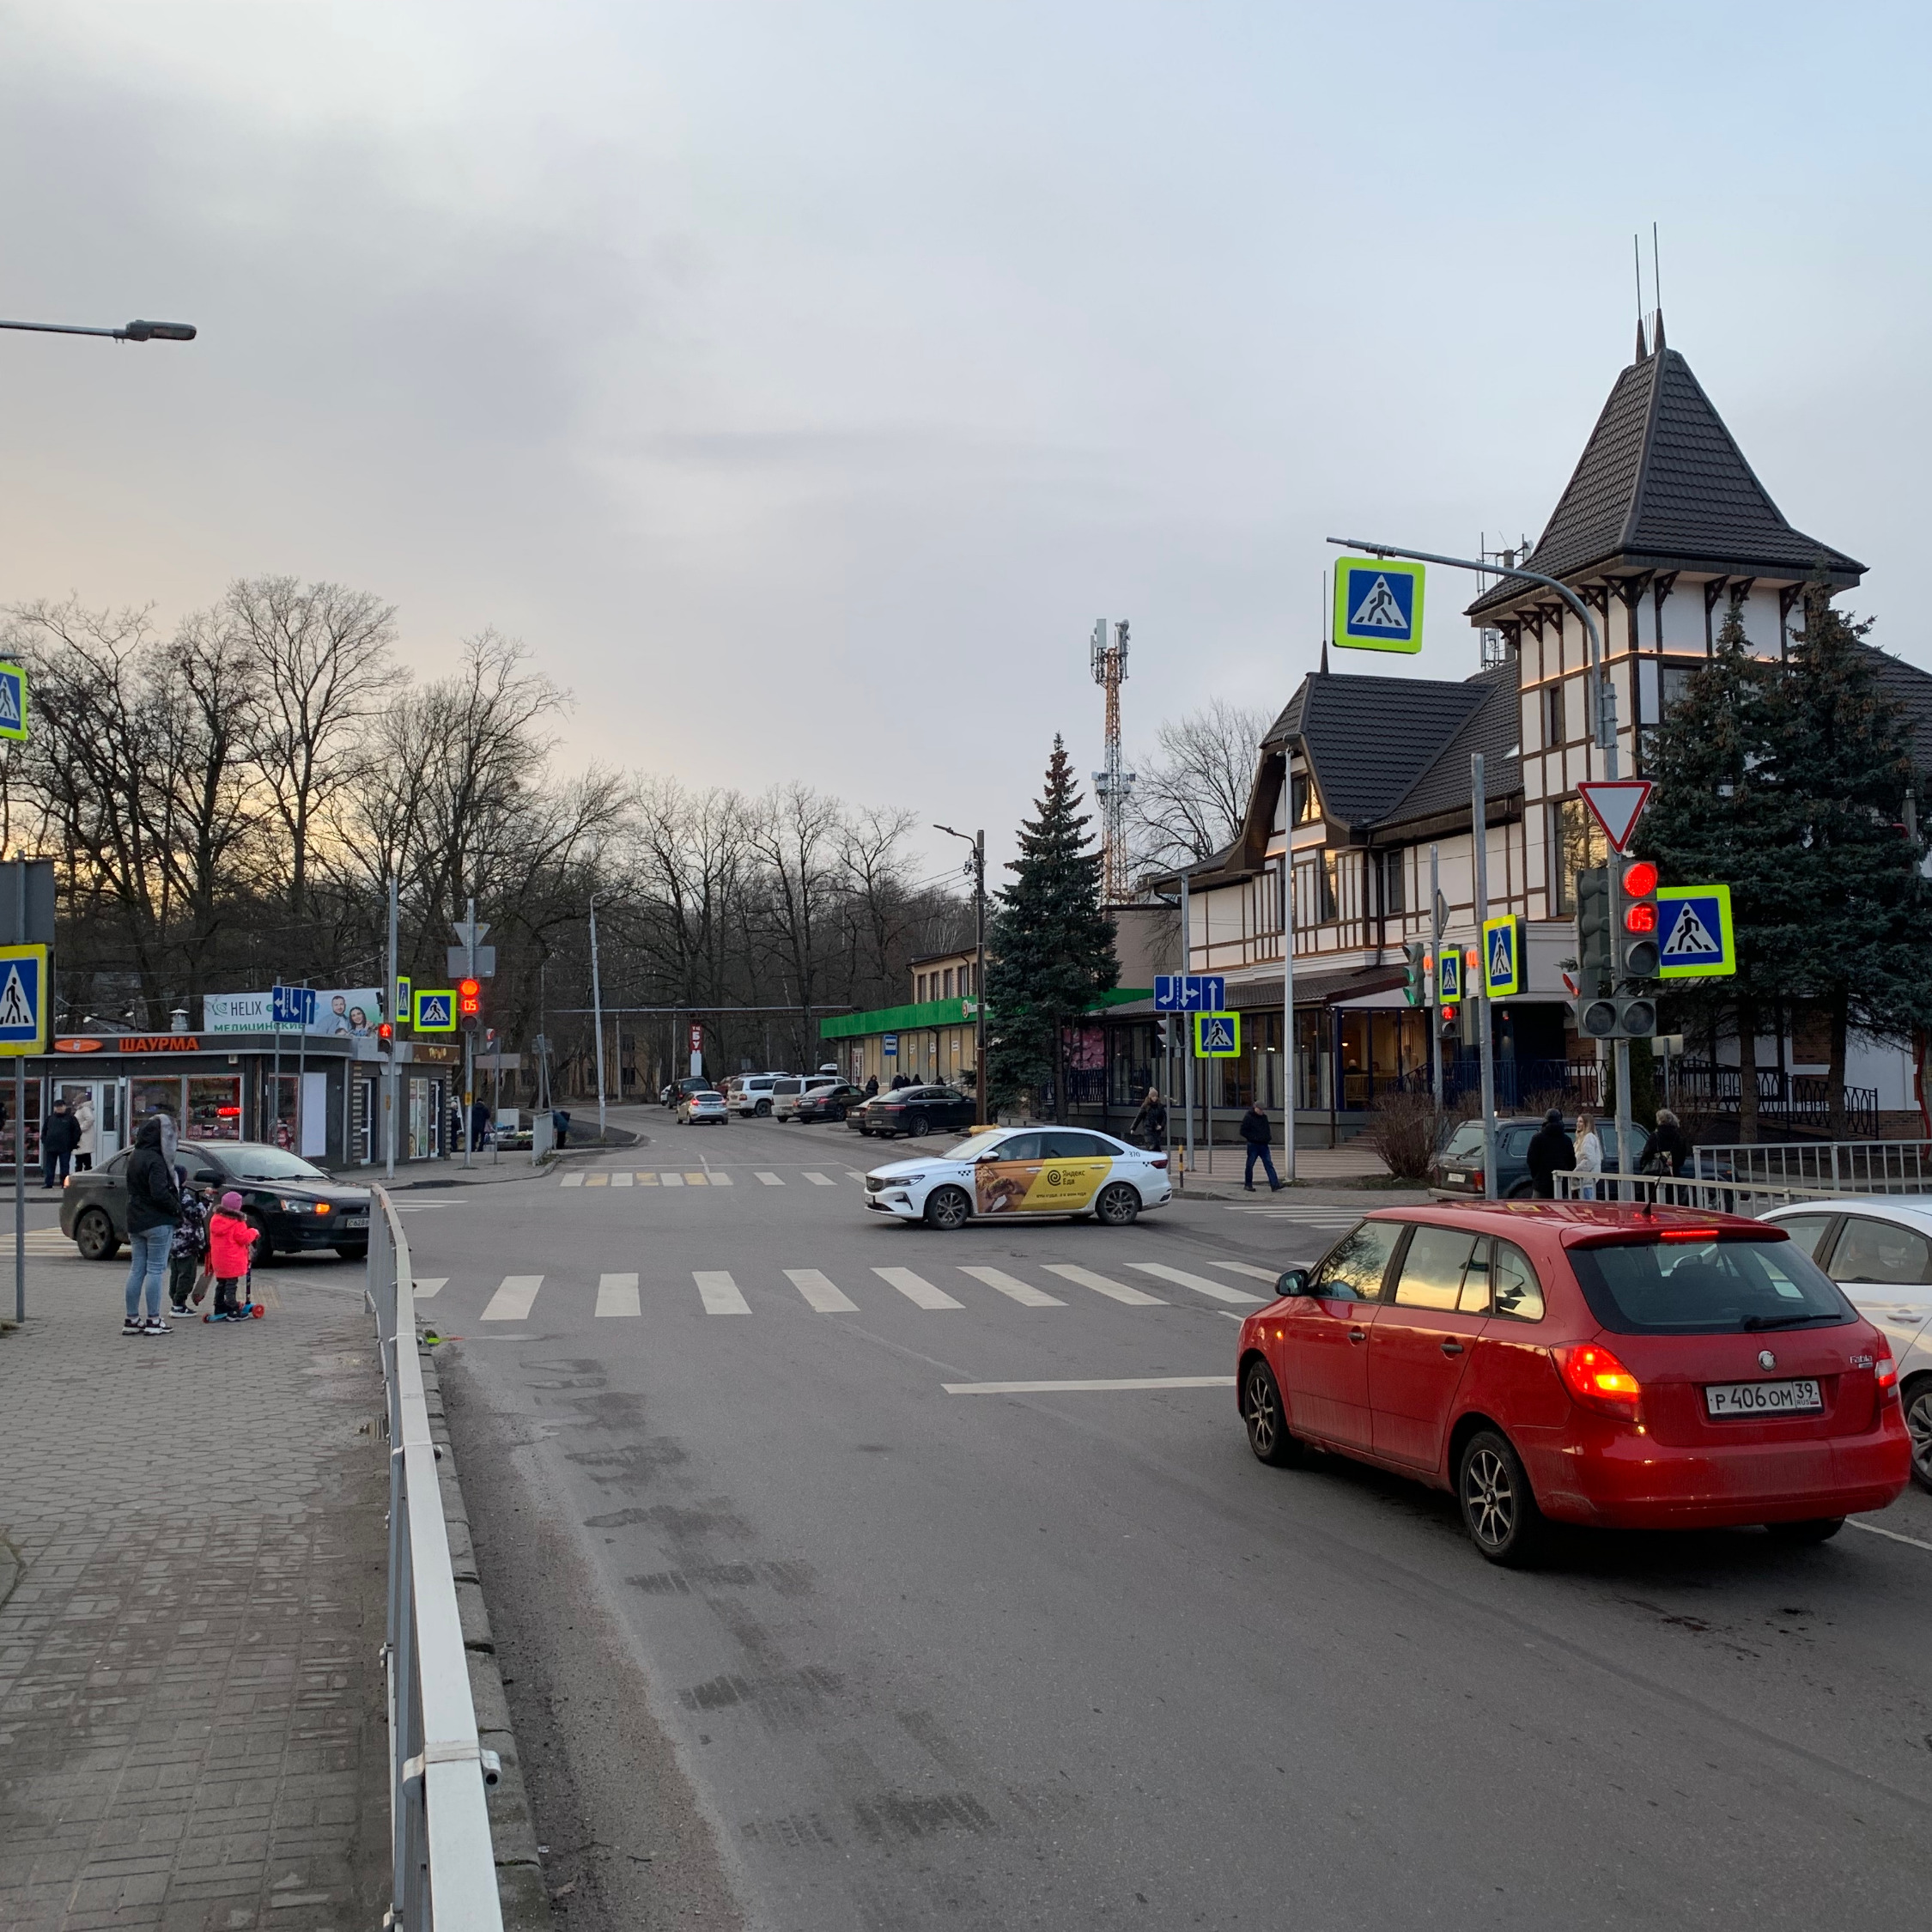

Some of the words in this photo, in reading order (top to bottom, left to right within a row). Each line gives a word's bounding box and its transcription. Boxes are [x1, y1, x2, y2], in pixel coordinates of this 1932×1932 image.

[230, 1000, 262, 1016] HELIX
[118, 1036, 199, 1052] ШАУРМА
[1062, 1177, 1075, 1186] Еда
